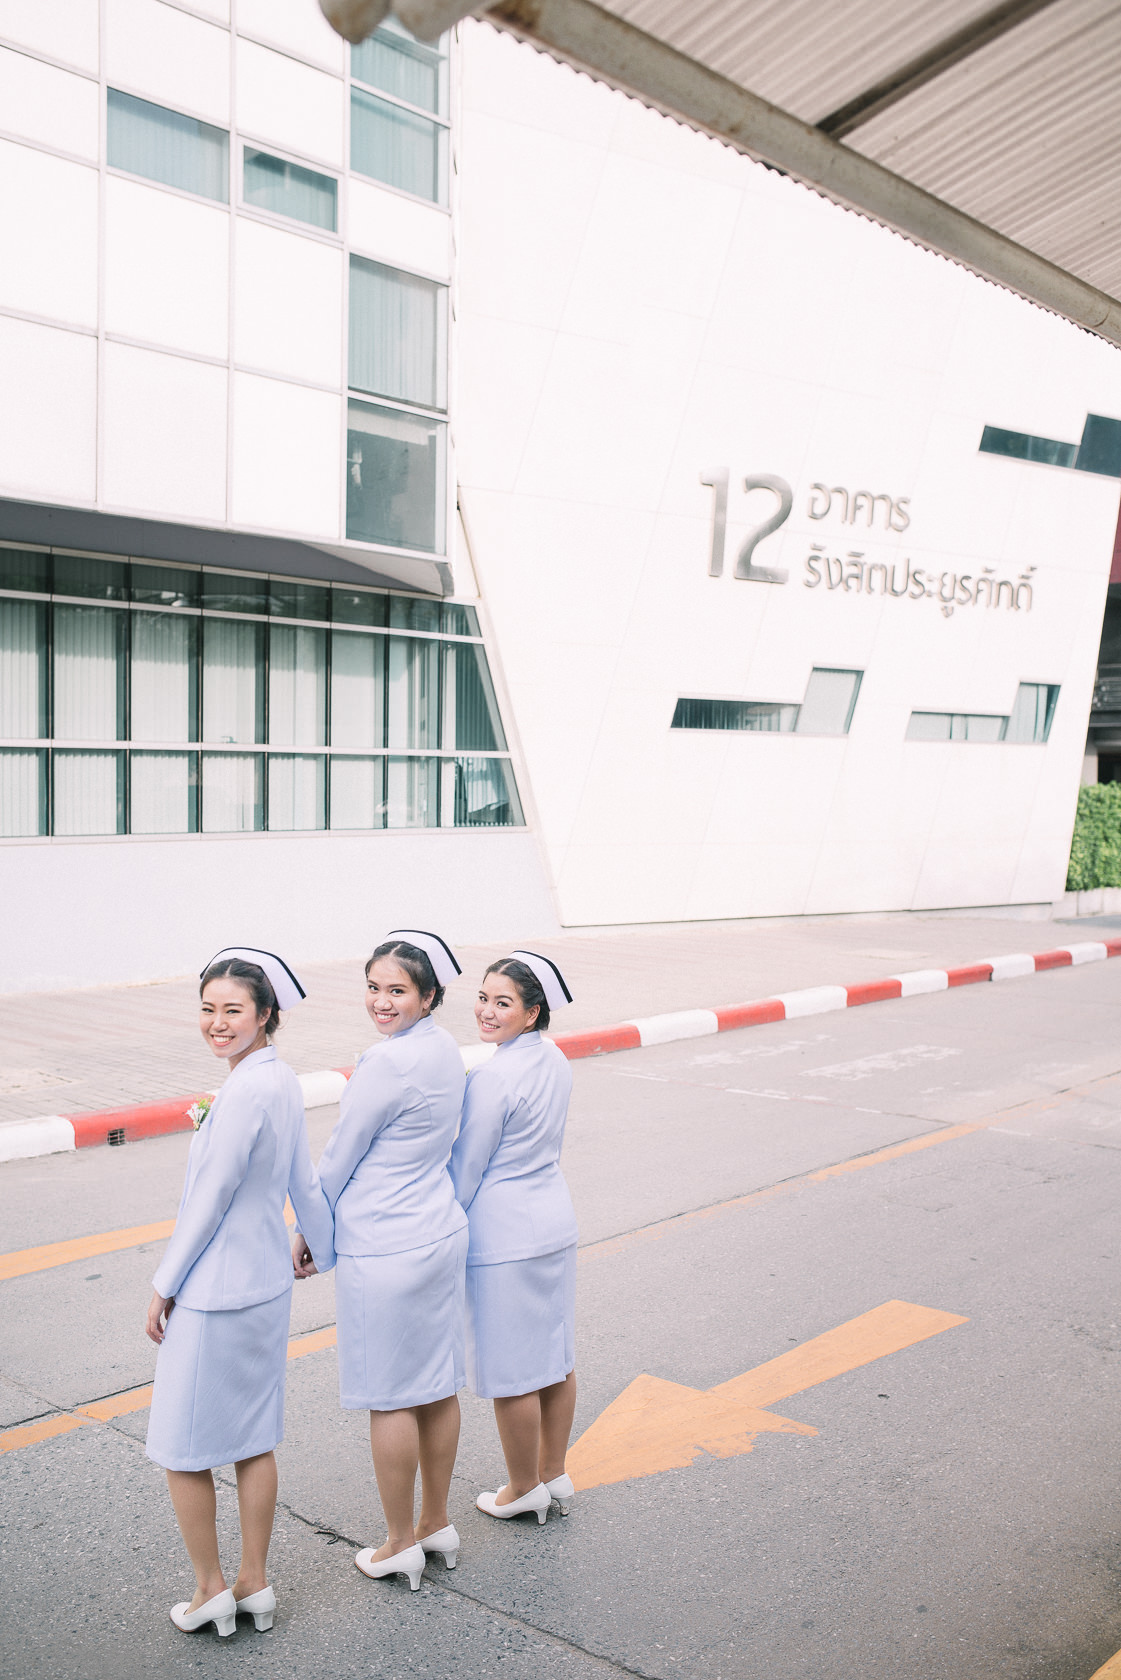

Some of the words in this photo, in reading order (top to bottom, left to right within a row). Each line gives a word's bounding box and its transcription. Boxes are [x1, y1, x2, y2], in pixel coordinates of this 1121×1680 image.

[700, 467, 793, 584] 12
[808, 482, 911, 532] อาคาร
[803, 543, 1038, 618] รังสิตประยูรศักดิ์
